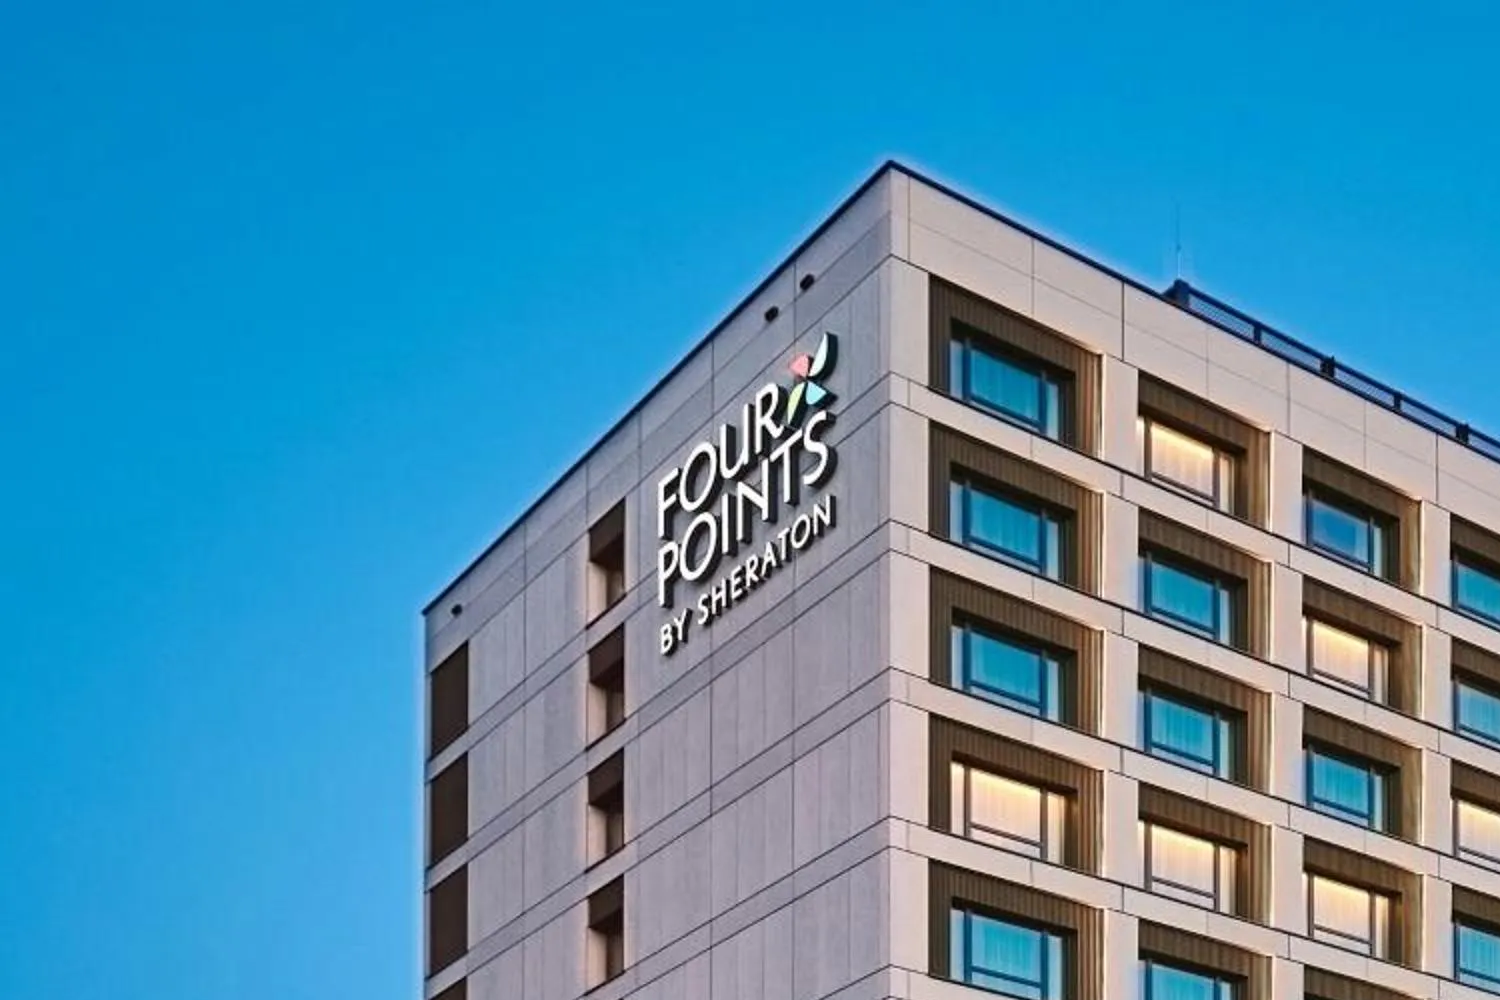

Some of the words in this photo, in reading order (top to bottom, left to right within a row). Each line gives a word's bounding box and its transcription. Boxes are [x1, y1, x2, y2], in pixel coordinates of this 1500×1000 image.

[657, 381, 784, 539] FOUR
[657, 410, 829, 607] POINTS
[660, 608, 688, 655] BY
[697, 495, 832, 625] SHERATON
